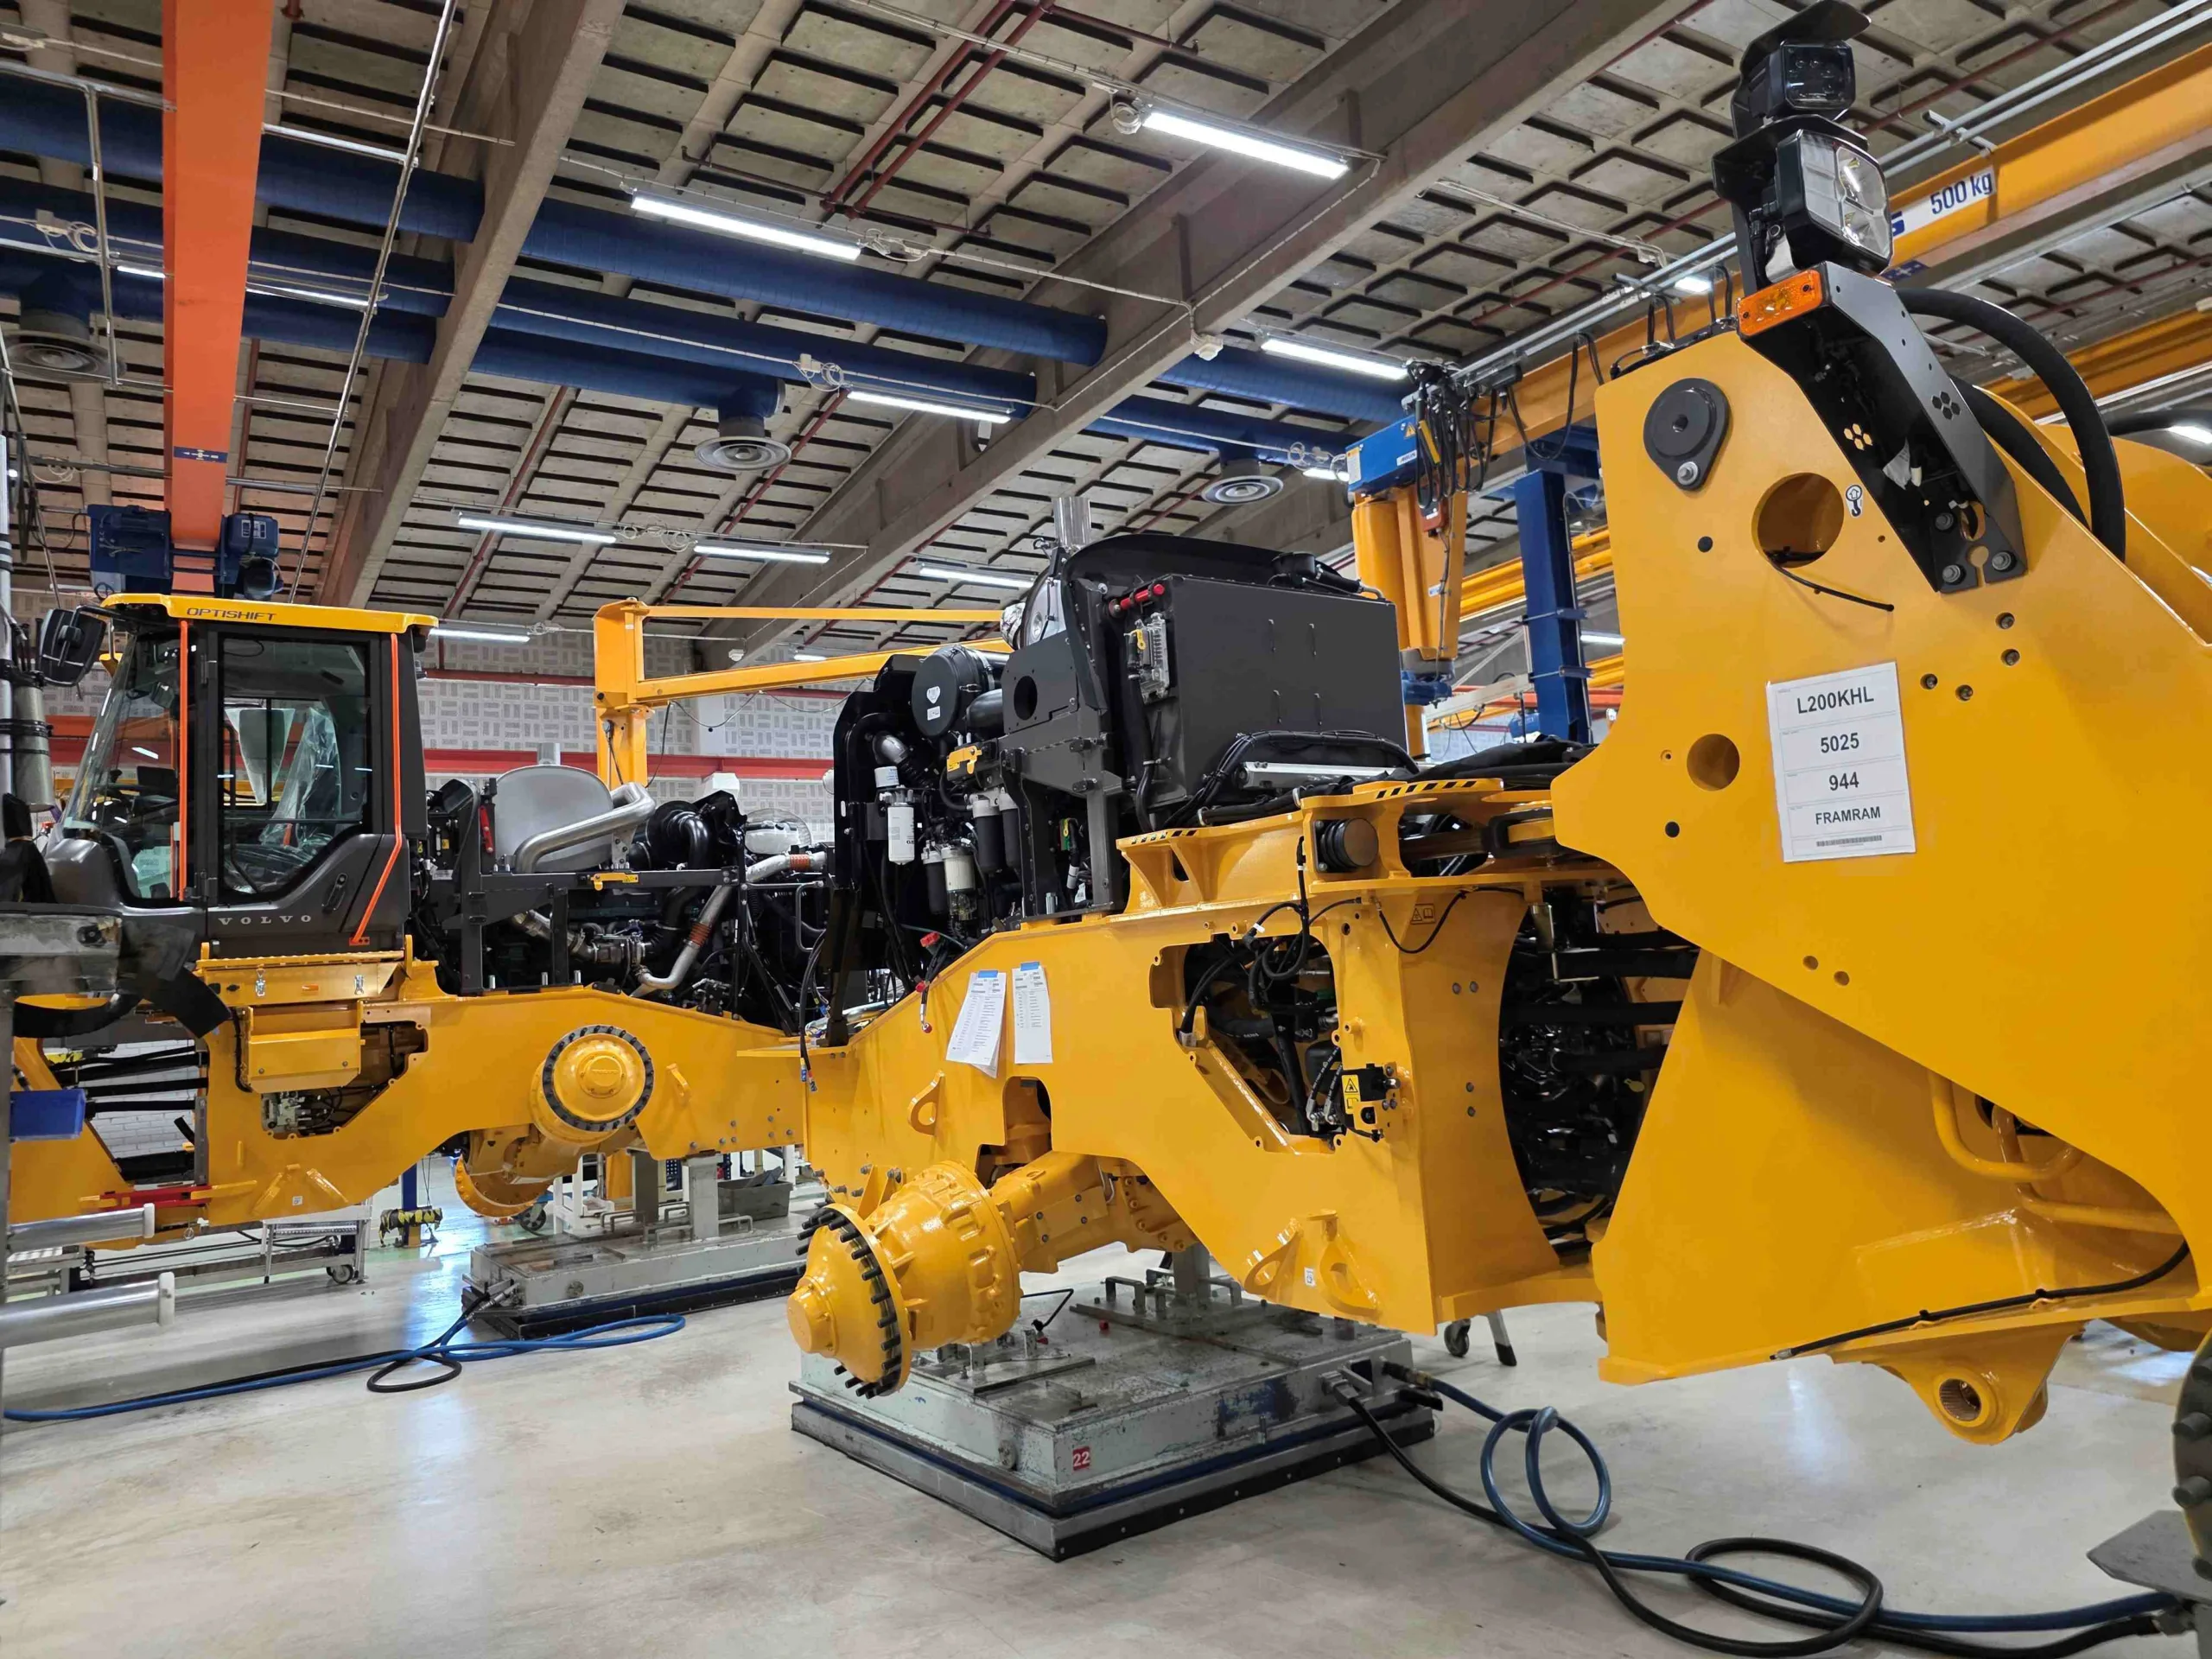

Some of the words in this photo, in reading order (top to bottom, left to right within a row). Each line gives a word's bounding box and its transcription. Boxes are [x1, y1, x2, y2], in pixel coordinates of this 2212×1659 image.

[1929, 181, 1967, 214] 500
[1969, 173, 1993, 197] kg
[187, 607, 276, 621] OPTISHIFT
[1797, 686, 1874, 714] L200KHL
[1821, 733, 1859, 753] 5025
[1828, 772, 1859, 791] 944
[1815, 806, 1881, 825] FRAMRAM
[218, 914, 311, 925] VOLVO
[1073, 1451, 1090, 1467] 22
